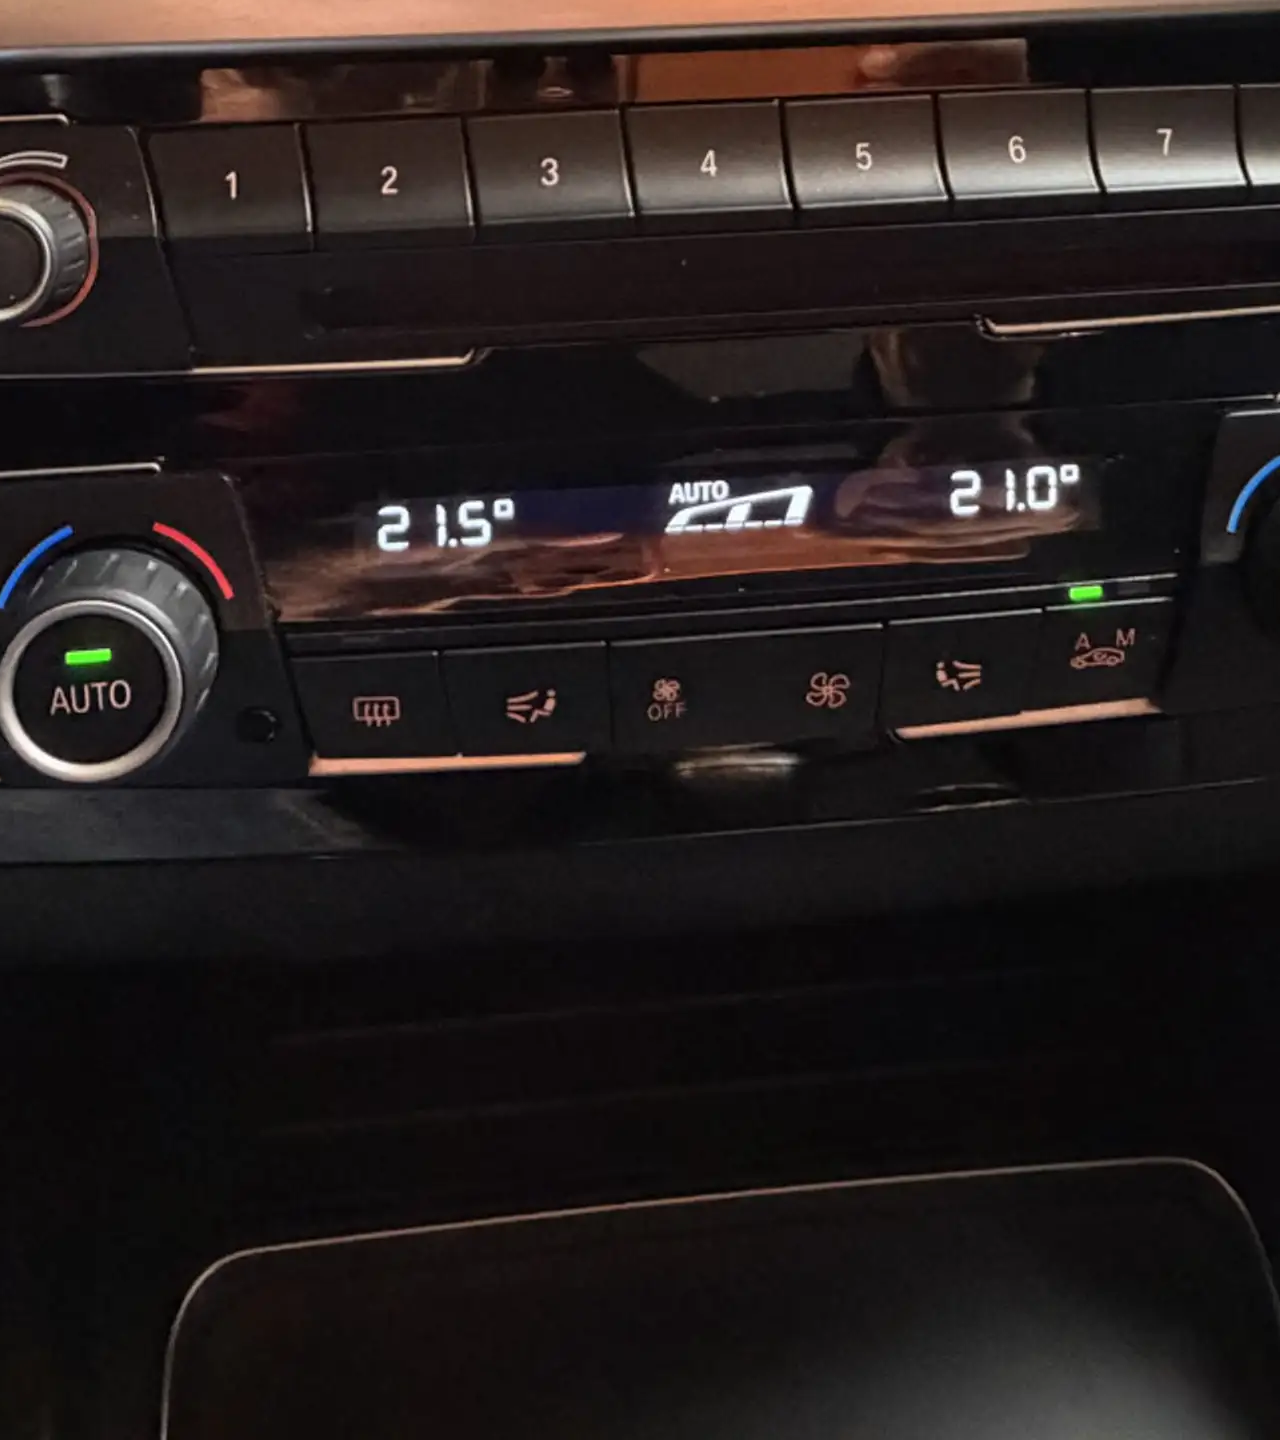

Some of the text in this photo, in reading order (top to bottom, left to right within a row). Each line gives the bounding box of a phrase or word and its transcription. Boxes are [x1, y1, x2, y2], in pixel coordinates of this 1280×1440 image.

[1008, 136, 1027, 163] 6
[1157, 128, 1173, 156] 7
[699, 149, 718, 177] 4
[855, 142, 873, 171] 5
[225, 172, 238, 198] 1
[380, 166, 399, 194] 2
[540, 158, 560, 187] 3
[669, 480, 730, 504] AUTO
[1074, 628, 1135, 650] A M
[49, 680, 131, 717] AUTO
[647, 701, 687, 722] OFF
